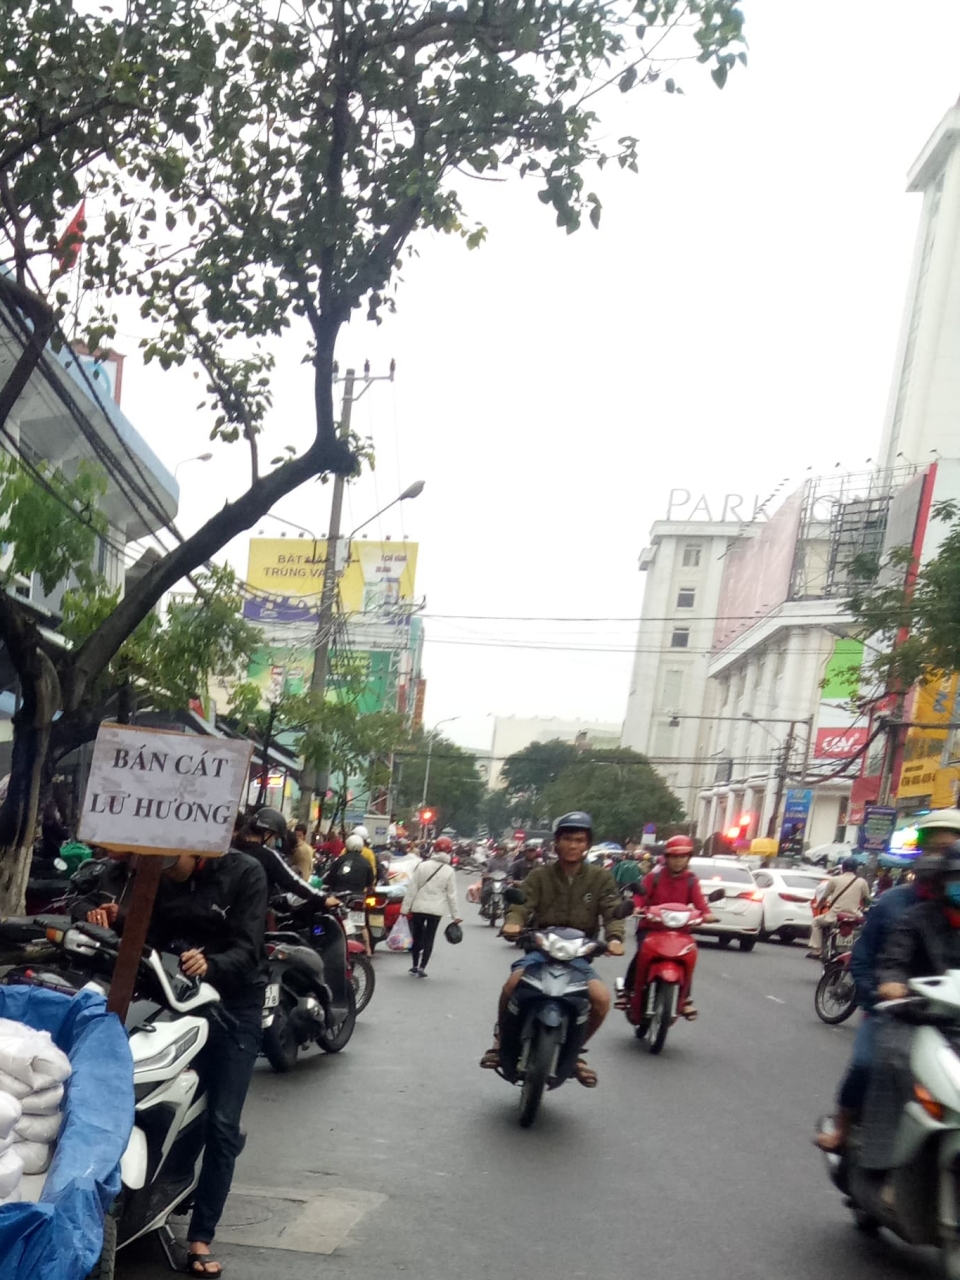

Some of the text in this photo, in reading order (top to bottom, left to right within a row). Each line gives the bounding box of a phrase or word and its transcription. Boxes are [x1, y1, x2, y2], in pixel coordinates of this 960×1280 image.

[263, 565, 308, 578] TRÚNG
[112, 743, 229, 778] BÁN CÁT
[90, 793, 232, 825] LƯ HƯƠNG
